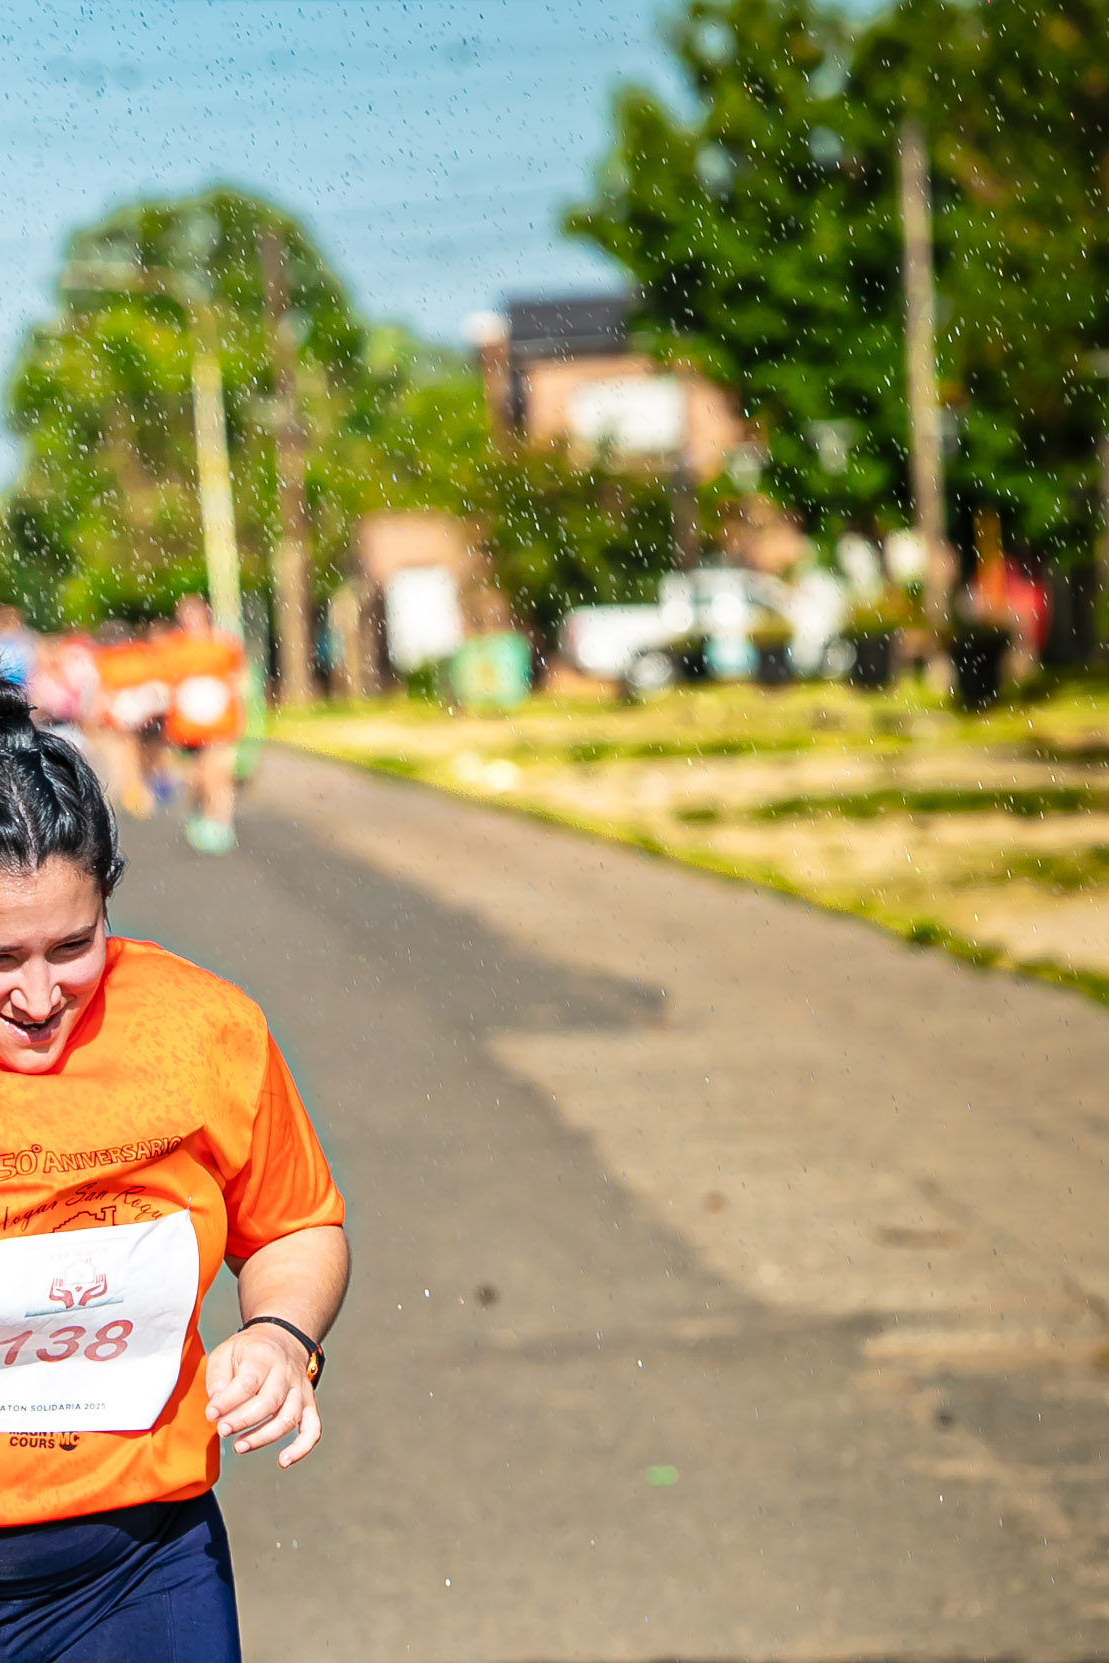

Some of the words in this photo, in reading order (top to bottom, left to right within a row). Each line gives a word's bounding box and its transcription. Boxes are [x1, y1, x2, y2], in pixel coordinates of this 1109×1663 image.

[43, 1136, 183, 1174] ANIVERSARIO
[65, 1181, 109, 1206] San
[113, 1185, 164, 1221] Roqu
[0, 1319, 134, 1366] 138
[30, 1403, 81, 1412] SOLIDARIA
[10, 1436, 56, 1449] COURS
